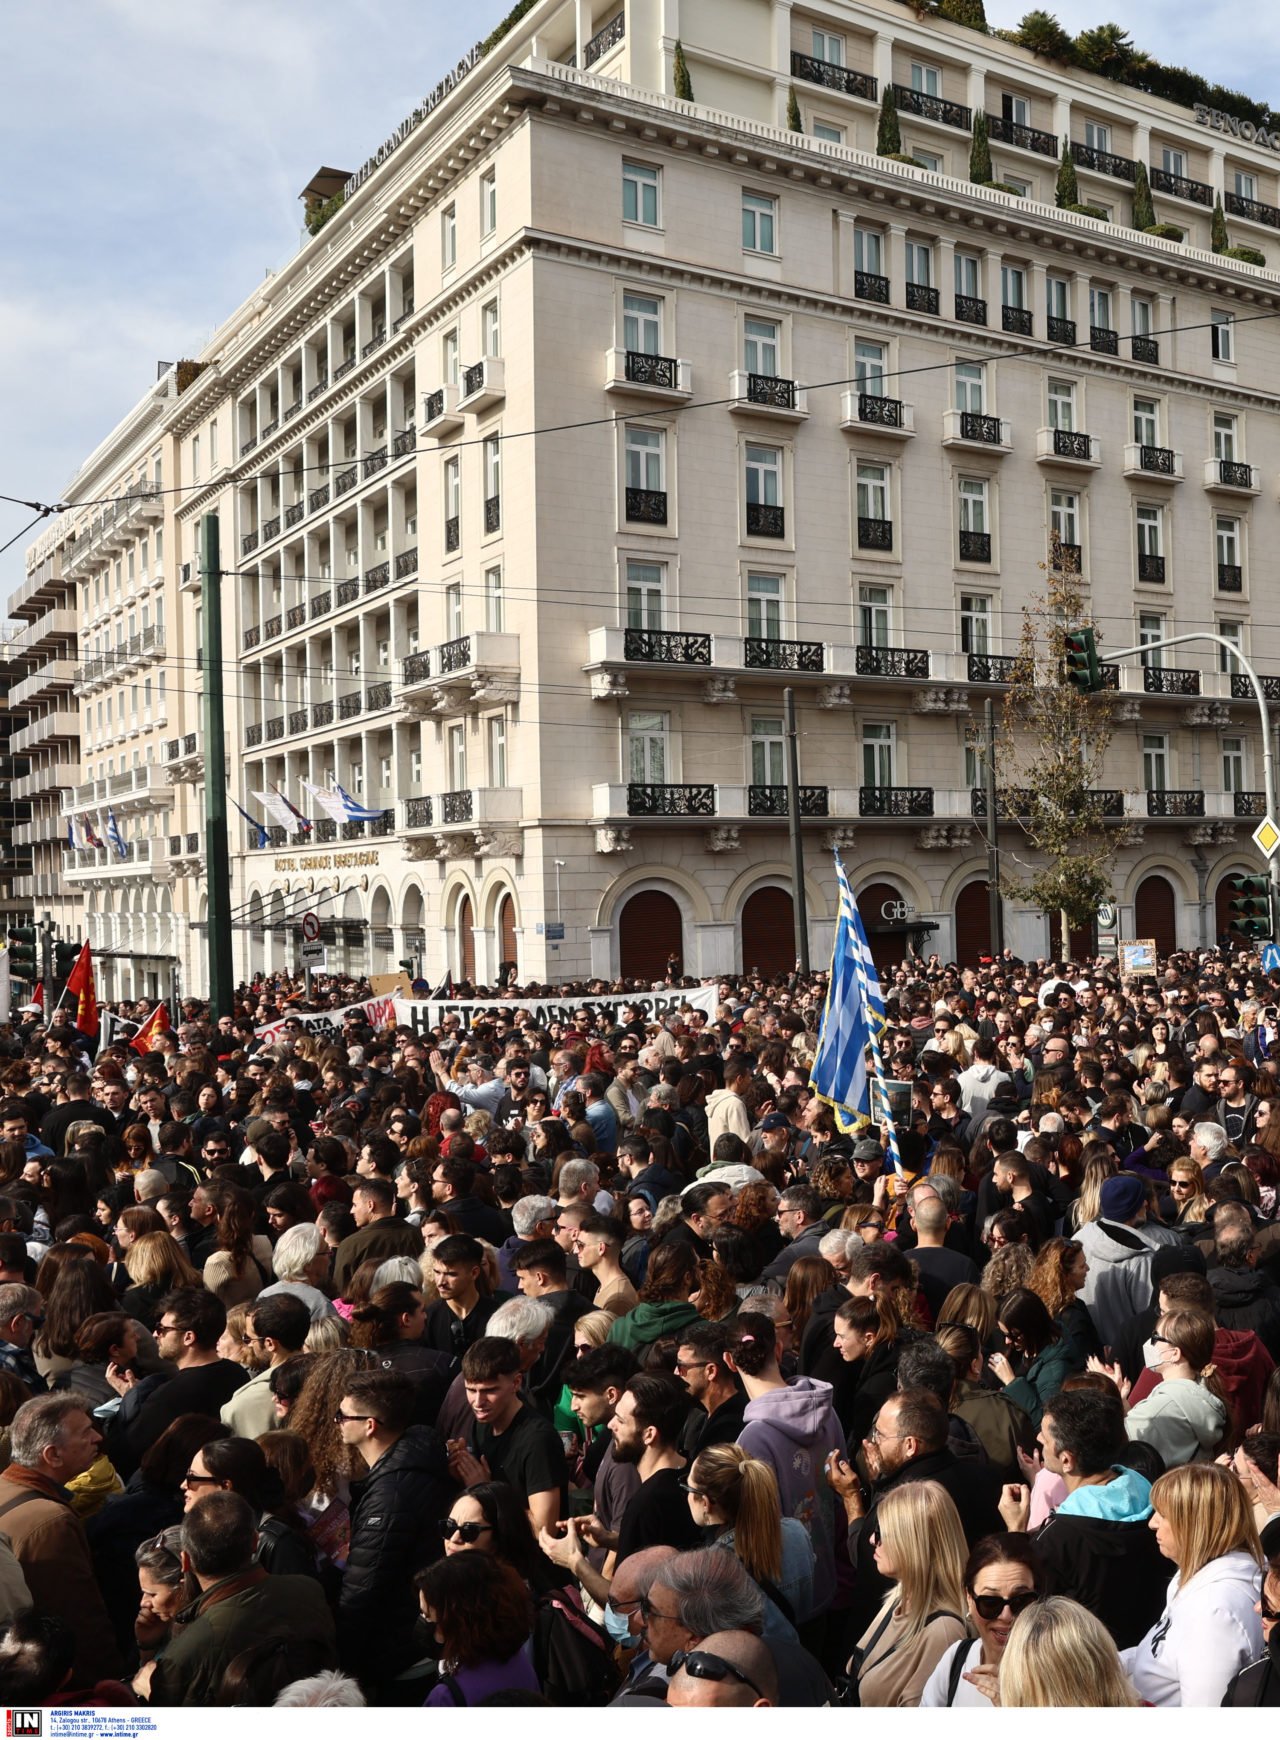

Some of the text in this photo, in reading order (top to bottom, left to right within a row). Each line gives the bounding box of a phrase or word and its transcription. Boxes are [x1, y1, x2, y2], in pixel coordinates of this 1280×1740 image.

[343, 40, 483, 201] HOTEL GRANDE BRETAGNE
